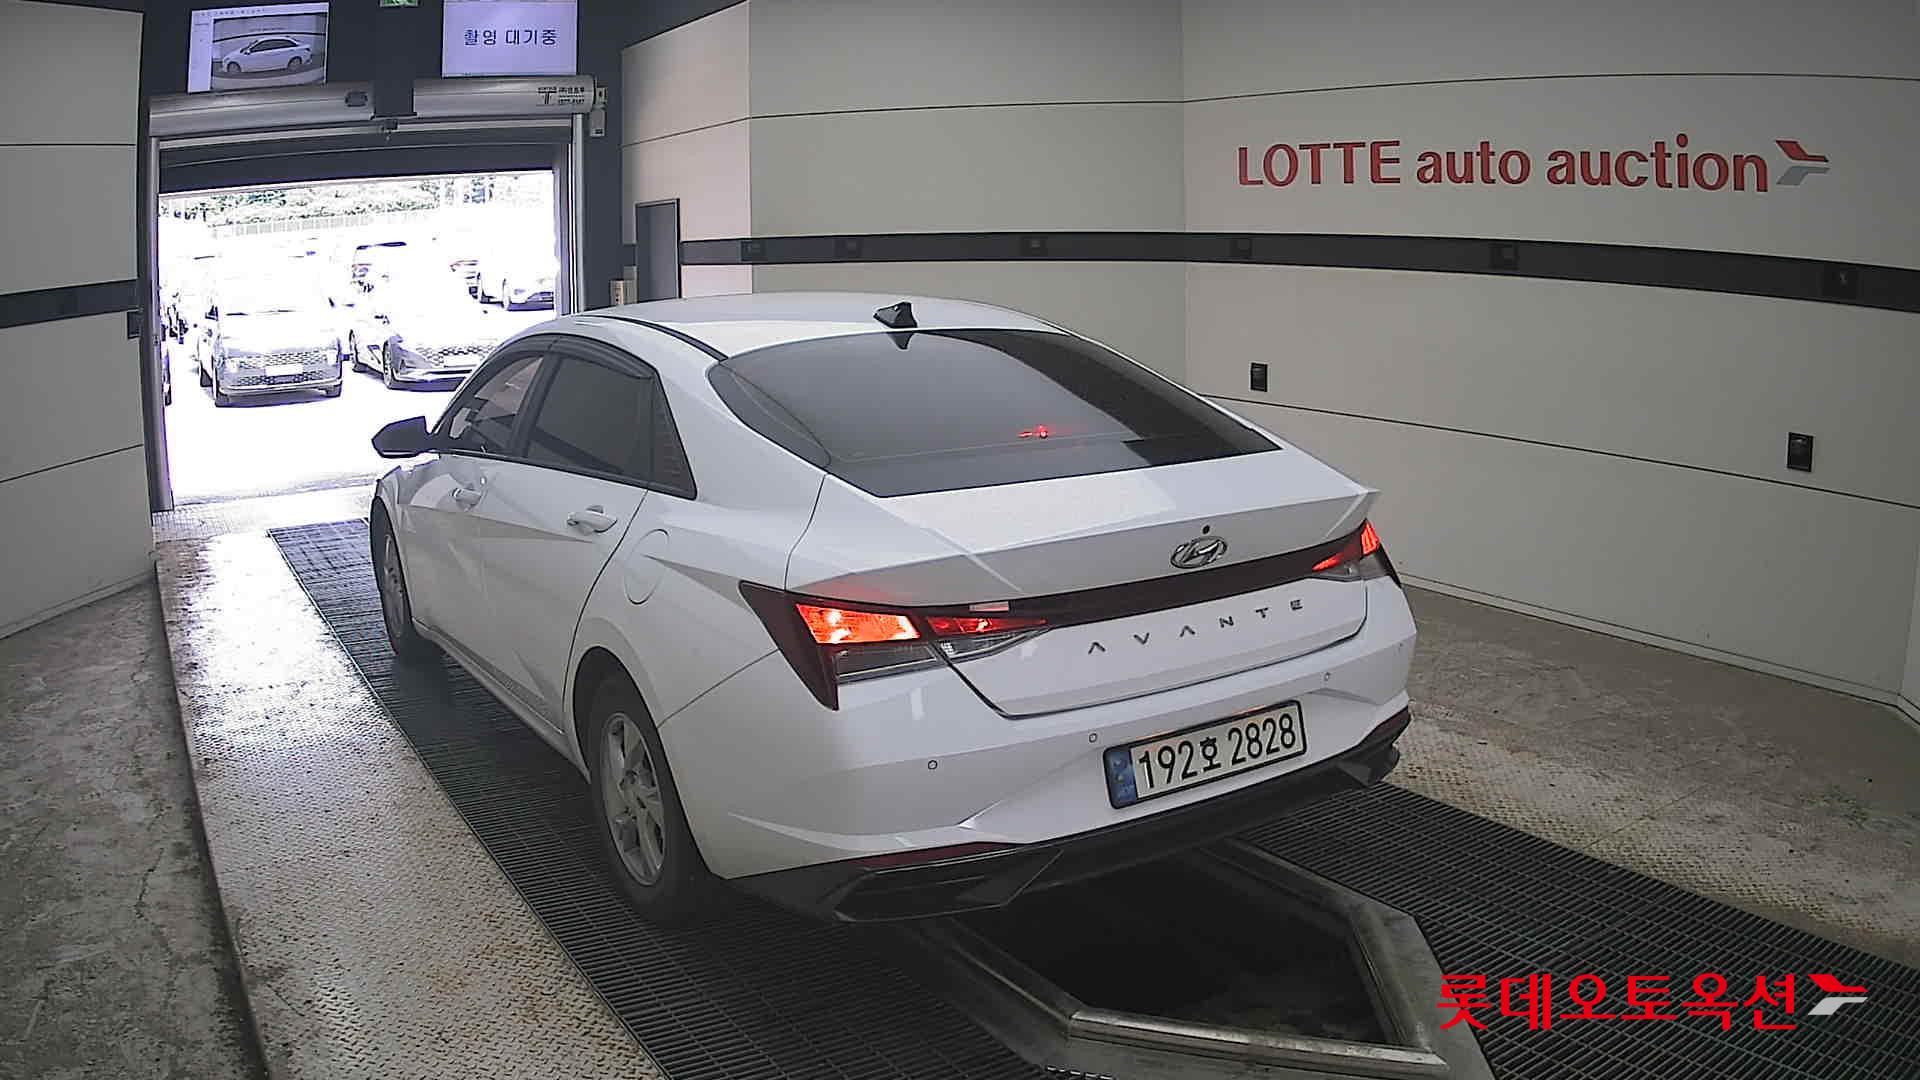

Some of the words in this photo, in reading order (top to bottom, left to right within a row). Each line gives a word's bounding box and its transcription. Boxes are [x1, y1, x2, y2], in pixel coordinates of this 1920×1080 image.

[464, 29, 498, 46] 촬영
[505, 28, 558, 46] 대기중
[1239, 140, 1401, 187] LOTTE
[1416, 141, 1531, 186] auto
[1546, 133, 1768, 193] auction
[1087, 599, 1303, 655] AVANTE
[1138, 737, 1222, 790] 192호
[1227, 713, 1297, 766] 2828
